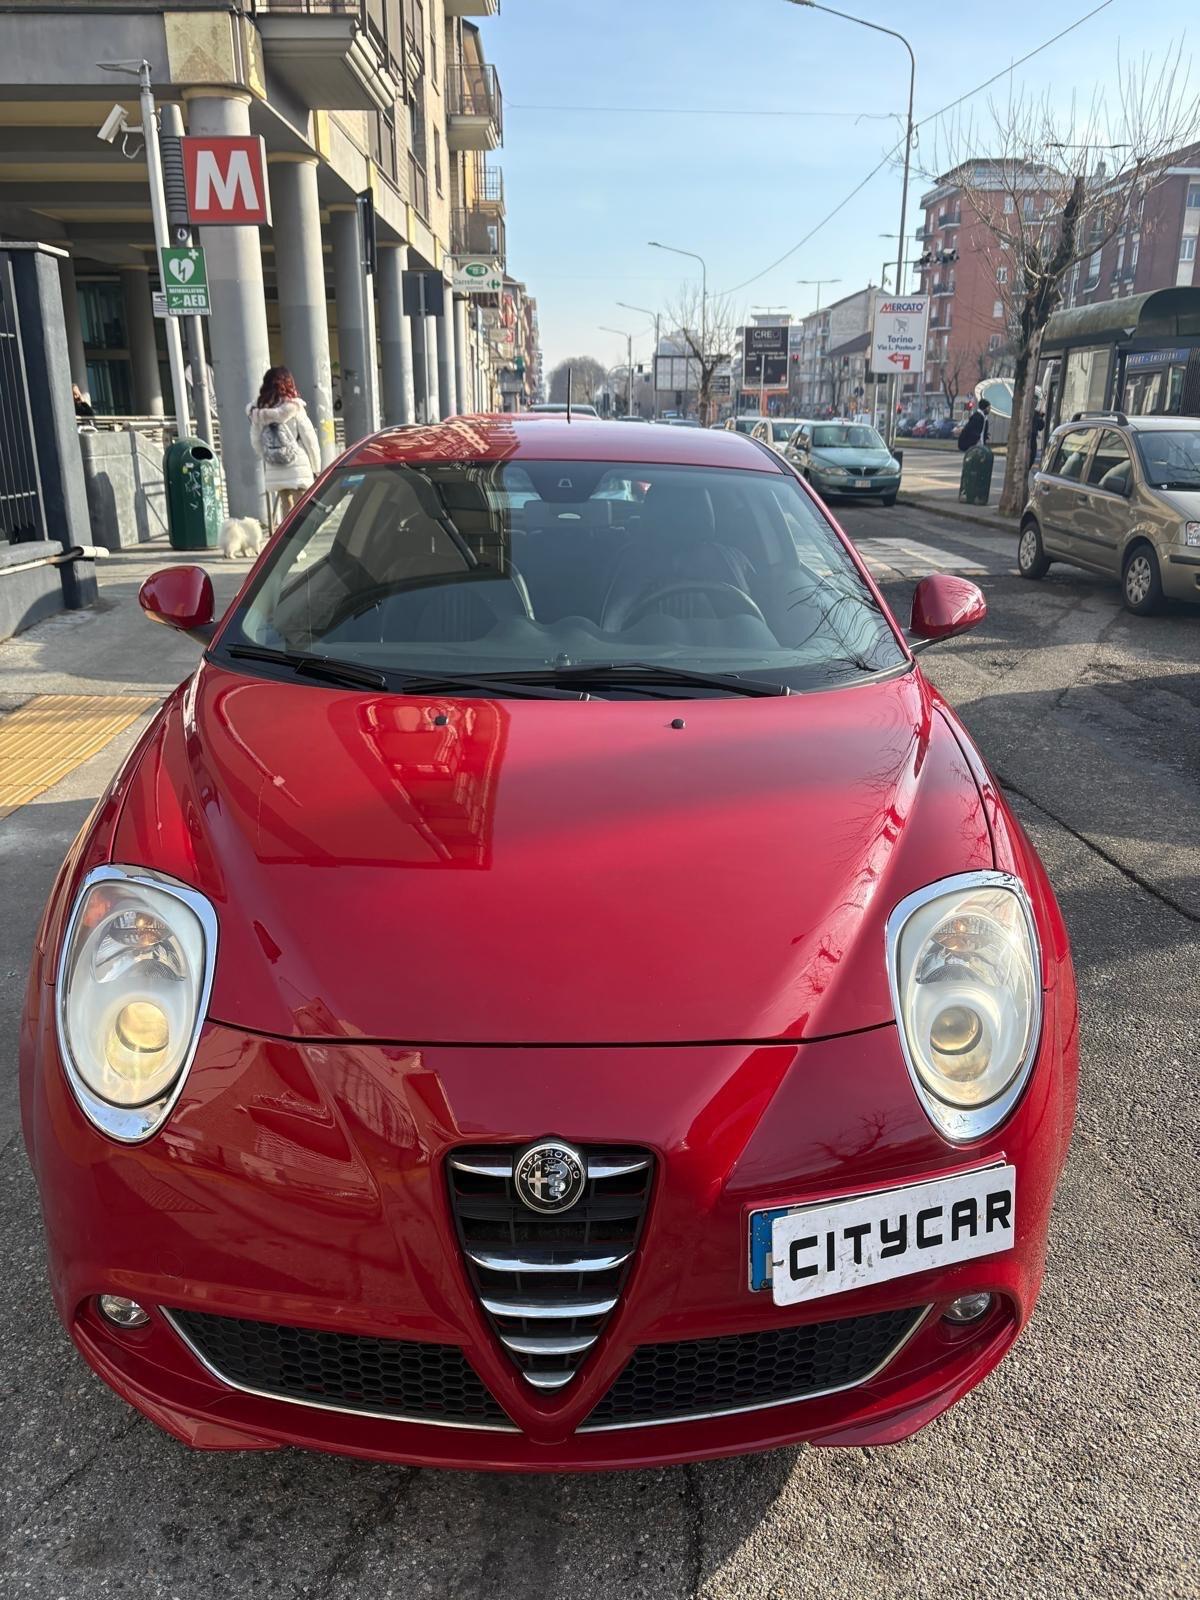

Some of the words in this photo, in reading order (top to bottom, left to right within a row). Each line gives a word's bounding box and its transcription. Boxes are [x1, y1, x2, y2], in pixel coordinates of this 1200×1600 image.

[195, 150, 260, 210] M
[183, 294, 206, 307] AED
[880, 302, 924, 313] MERCATO
[888, 334, 913, 344] Torino
[521, 1153, 543, 1181] ALFA
[545, 1149, 580, 1179] ROMEO
[789, 1189, 1012, 1281] CITYCAR
